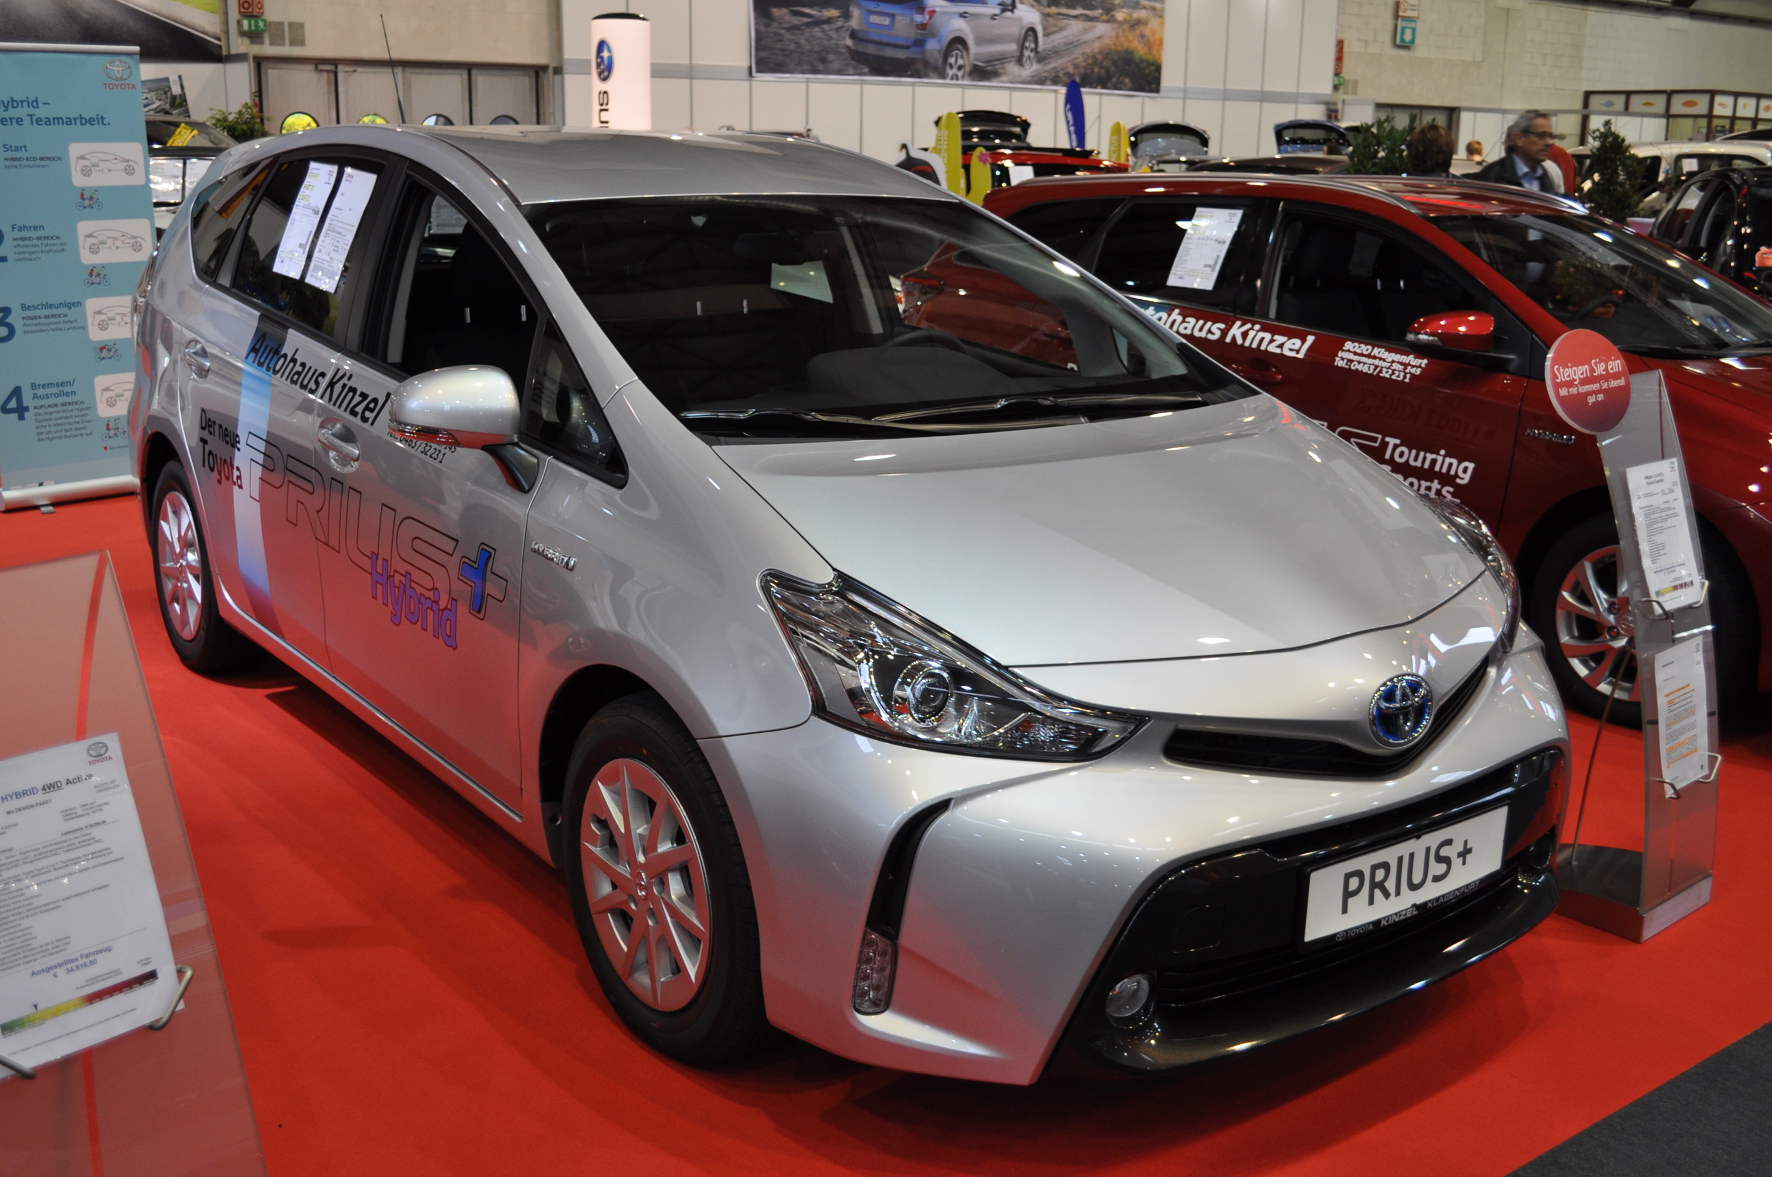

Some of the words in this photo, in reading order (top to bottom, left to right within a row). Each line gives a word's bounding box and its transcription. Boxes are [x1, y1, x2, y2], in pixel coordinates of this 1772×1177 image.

[103, 83, 136, 91] TOYOTA
[0, 96, 40, 112] ybrid
[598, 90, 610, 129] SU
[26, 113, 111, 127] Teamarbeit.
[2, 143, 28, 153] Start
[11, 223, 45, 233] Fahren
[20, 301, 82, 313] Beschleunigen
[1142, 306, 1226, 341] tohaus
[1225, 319, 1315, 358] Kinzel
[1342, 341, 1372, 355] 9020
[1371, 347, 1429, 368] Klagenfurt
[1350, 361, 1375, 374] 0463
[31, 378, 76, 391] Bremsen/
[246, 331, 321, 395] Autohaus
[321, 366, 391, 427] Kinzel
[1553, 363, 1590, 385] Steigen
[1591, 359, 1607, 376] Sie
[1607, 356, 1622, 373] ein
[0, 386, 30, 421] 4
[32, 390, 77, 401] Ausrollen
[1596, 393, 1605, 401] an
[200, 407, 217, 440] Der
[216, 423, 242, 453] neue
[200, 437, 243, 491] Toyota
[1384, 436, 1476, 485] Touring
[1382, 464, 1461, 503] orts
[369, 551, 458, 650] Hybrid
[0, 786, 39, 803] HYBRID
[41, 779, 63, 794] 4WD
[1340, 837, 1473, 915] PRIUS+
[1347, 923, 1374, 937] TOYOTA
[1379, 906, 1419, 927] KINZEL
